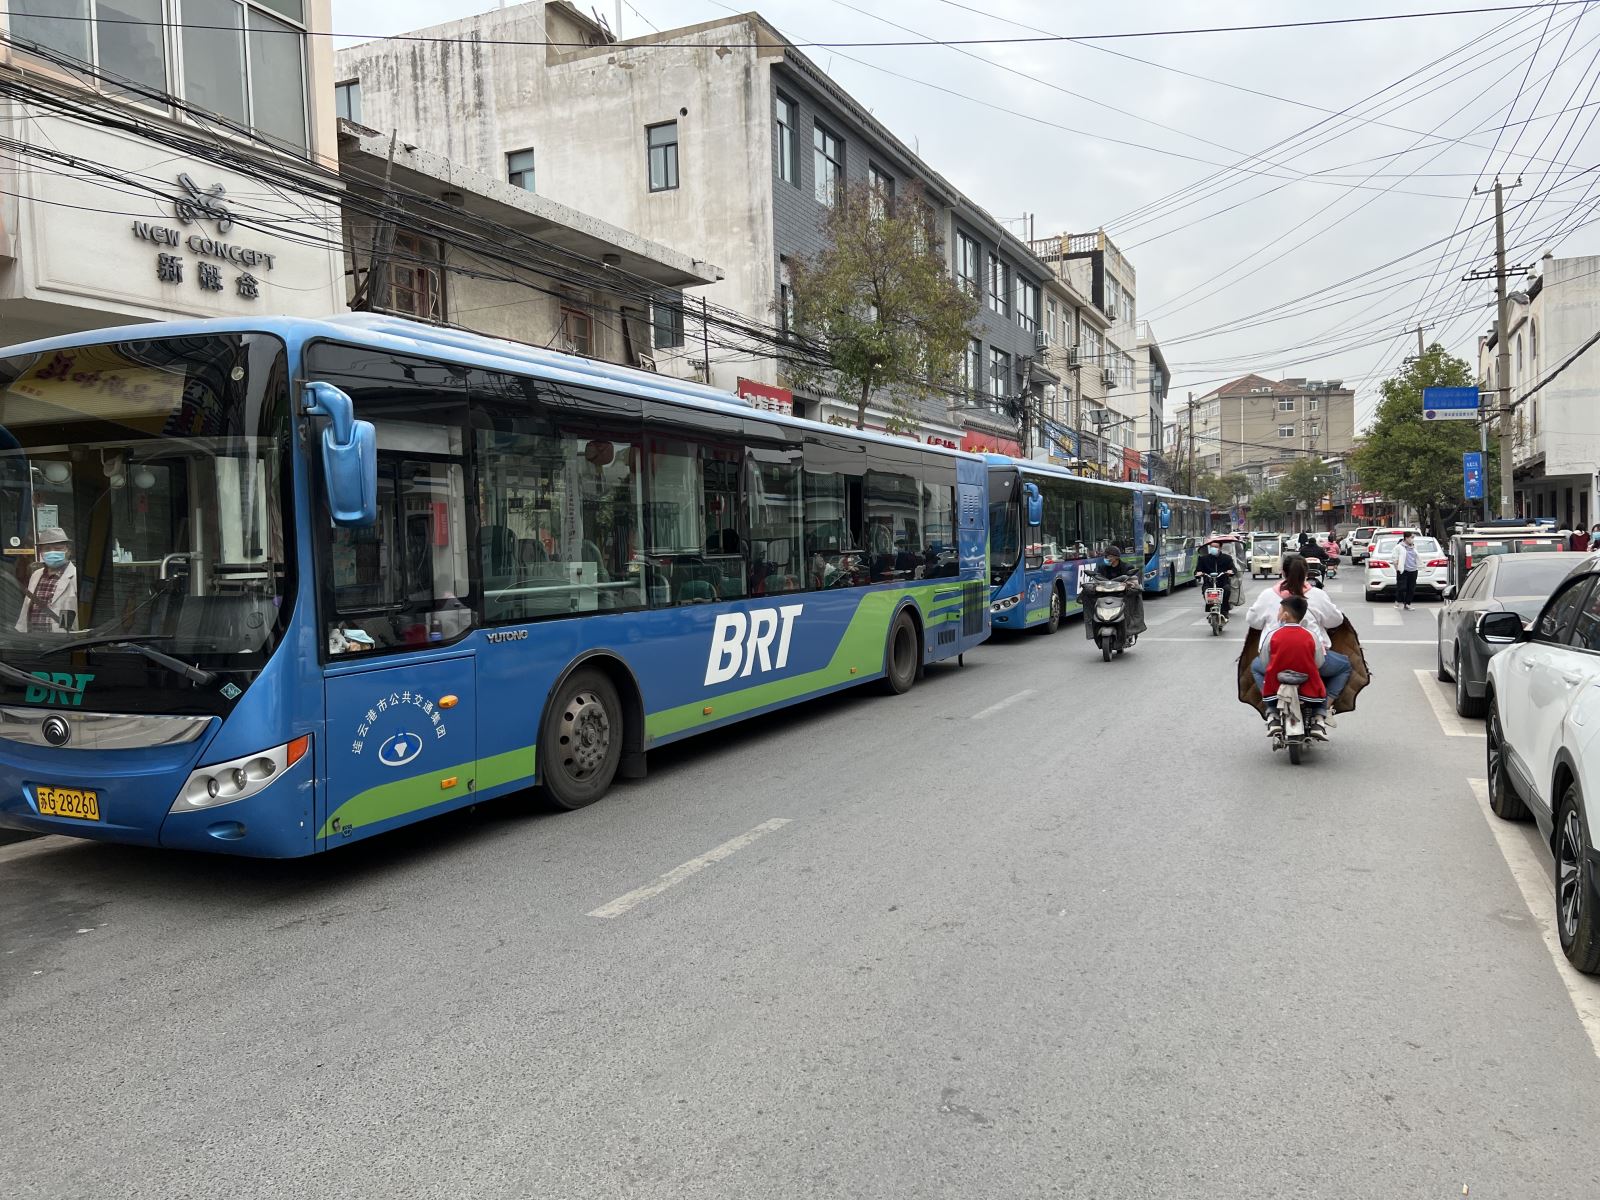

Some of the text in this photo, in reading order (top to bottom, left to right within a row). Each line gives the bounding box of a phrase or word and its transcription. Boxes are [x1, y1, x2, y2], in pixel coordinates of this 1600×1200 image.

[133, 221, 276, 271] NEW CONCEPT
[157, 253, 260, 299] 新概念
[487, 630, 528, 644] YUTONG
[704, 603, 803, 686] BRT
[25, 671, 95, 705] BRT
[352, 691, 447, 754] 连云港市公共交通集团
